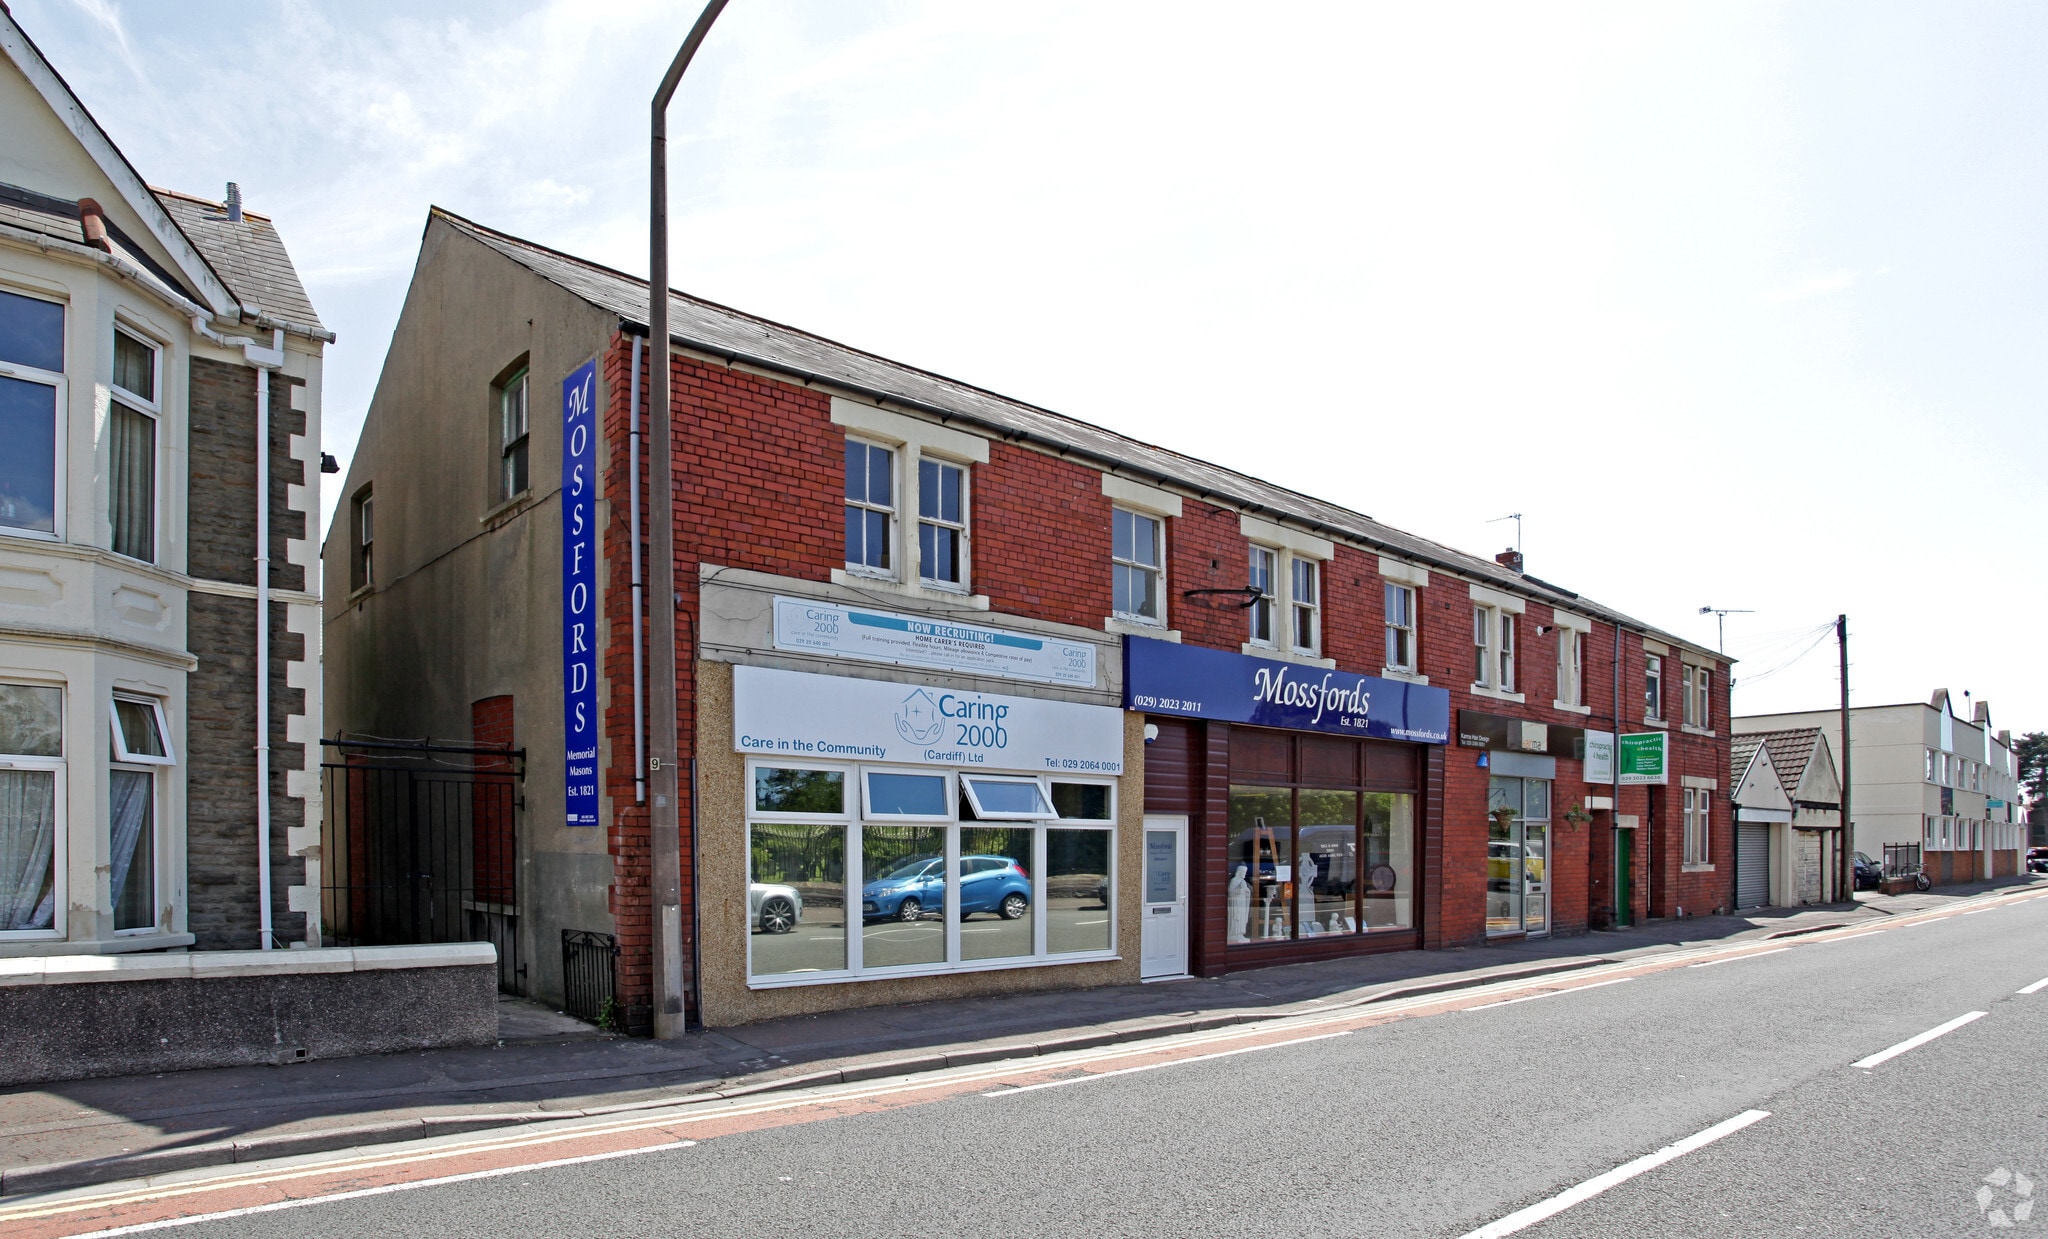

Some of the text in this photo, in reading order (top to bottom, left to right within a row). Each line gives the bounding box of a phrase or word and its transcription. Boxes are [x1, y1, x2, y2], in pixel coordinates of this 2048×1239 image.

[806, 609, 840, 626] Caring
[814, 622, 839, 635] 2000
[907, 621, 994, 643] NOW RECRUITING!
[872, 636, 890, 644] training
[943, 645, 960, 653] Mileage
[985, 651, 1008, 660] Competitive
[915, 635, 987, 650] HOME CARER'S REQUIRED.
[1062, 647, 1087, 661] Caring
[1068, 658, 1087, 669] 2000
[1253, 666, 1370, 724] Mossfords
[1134, 694, 1202, 713] (029) 2023 2011
[939, 694, 1009, 729] Caring
[1340, 715, 1369, 728] Est. 1821
[956, 724, 1008, 748] 2000
[1390, 727, 1448, 741] www.mossfords.co.uk
[741, 735, 886, 759] Care in the Community
[1621, 737, 1662, 746] chiropractic
[567, 747, 595, 761] Memorial
[924, 749, 984, 763] (Cardiff) Ltd
[569, 765, 593, 777] Masons
[651, 758, 658, 770] 9
[1045, 757, 1120, 771] Tel: 029 2064 0001
[568, 784, 594, 797] Est. 1821
